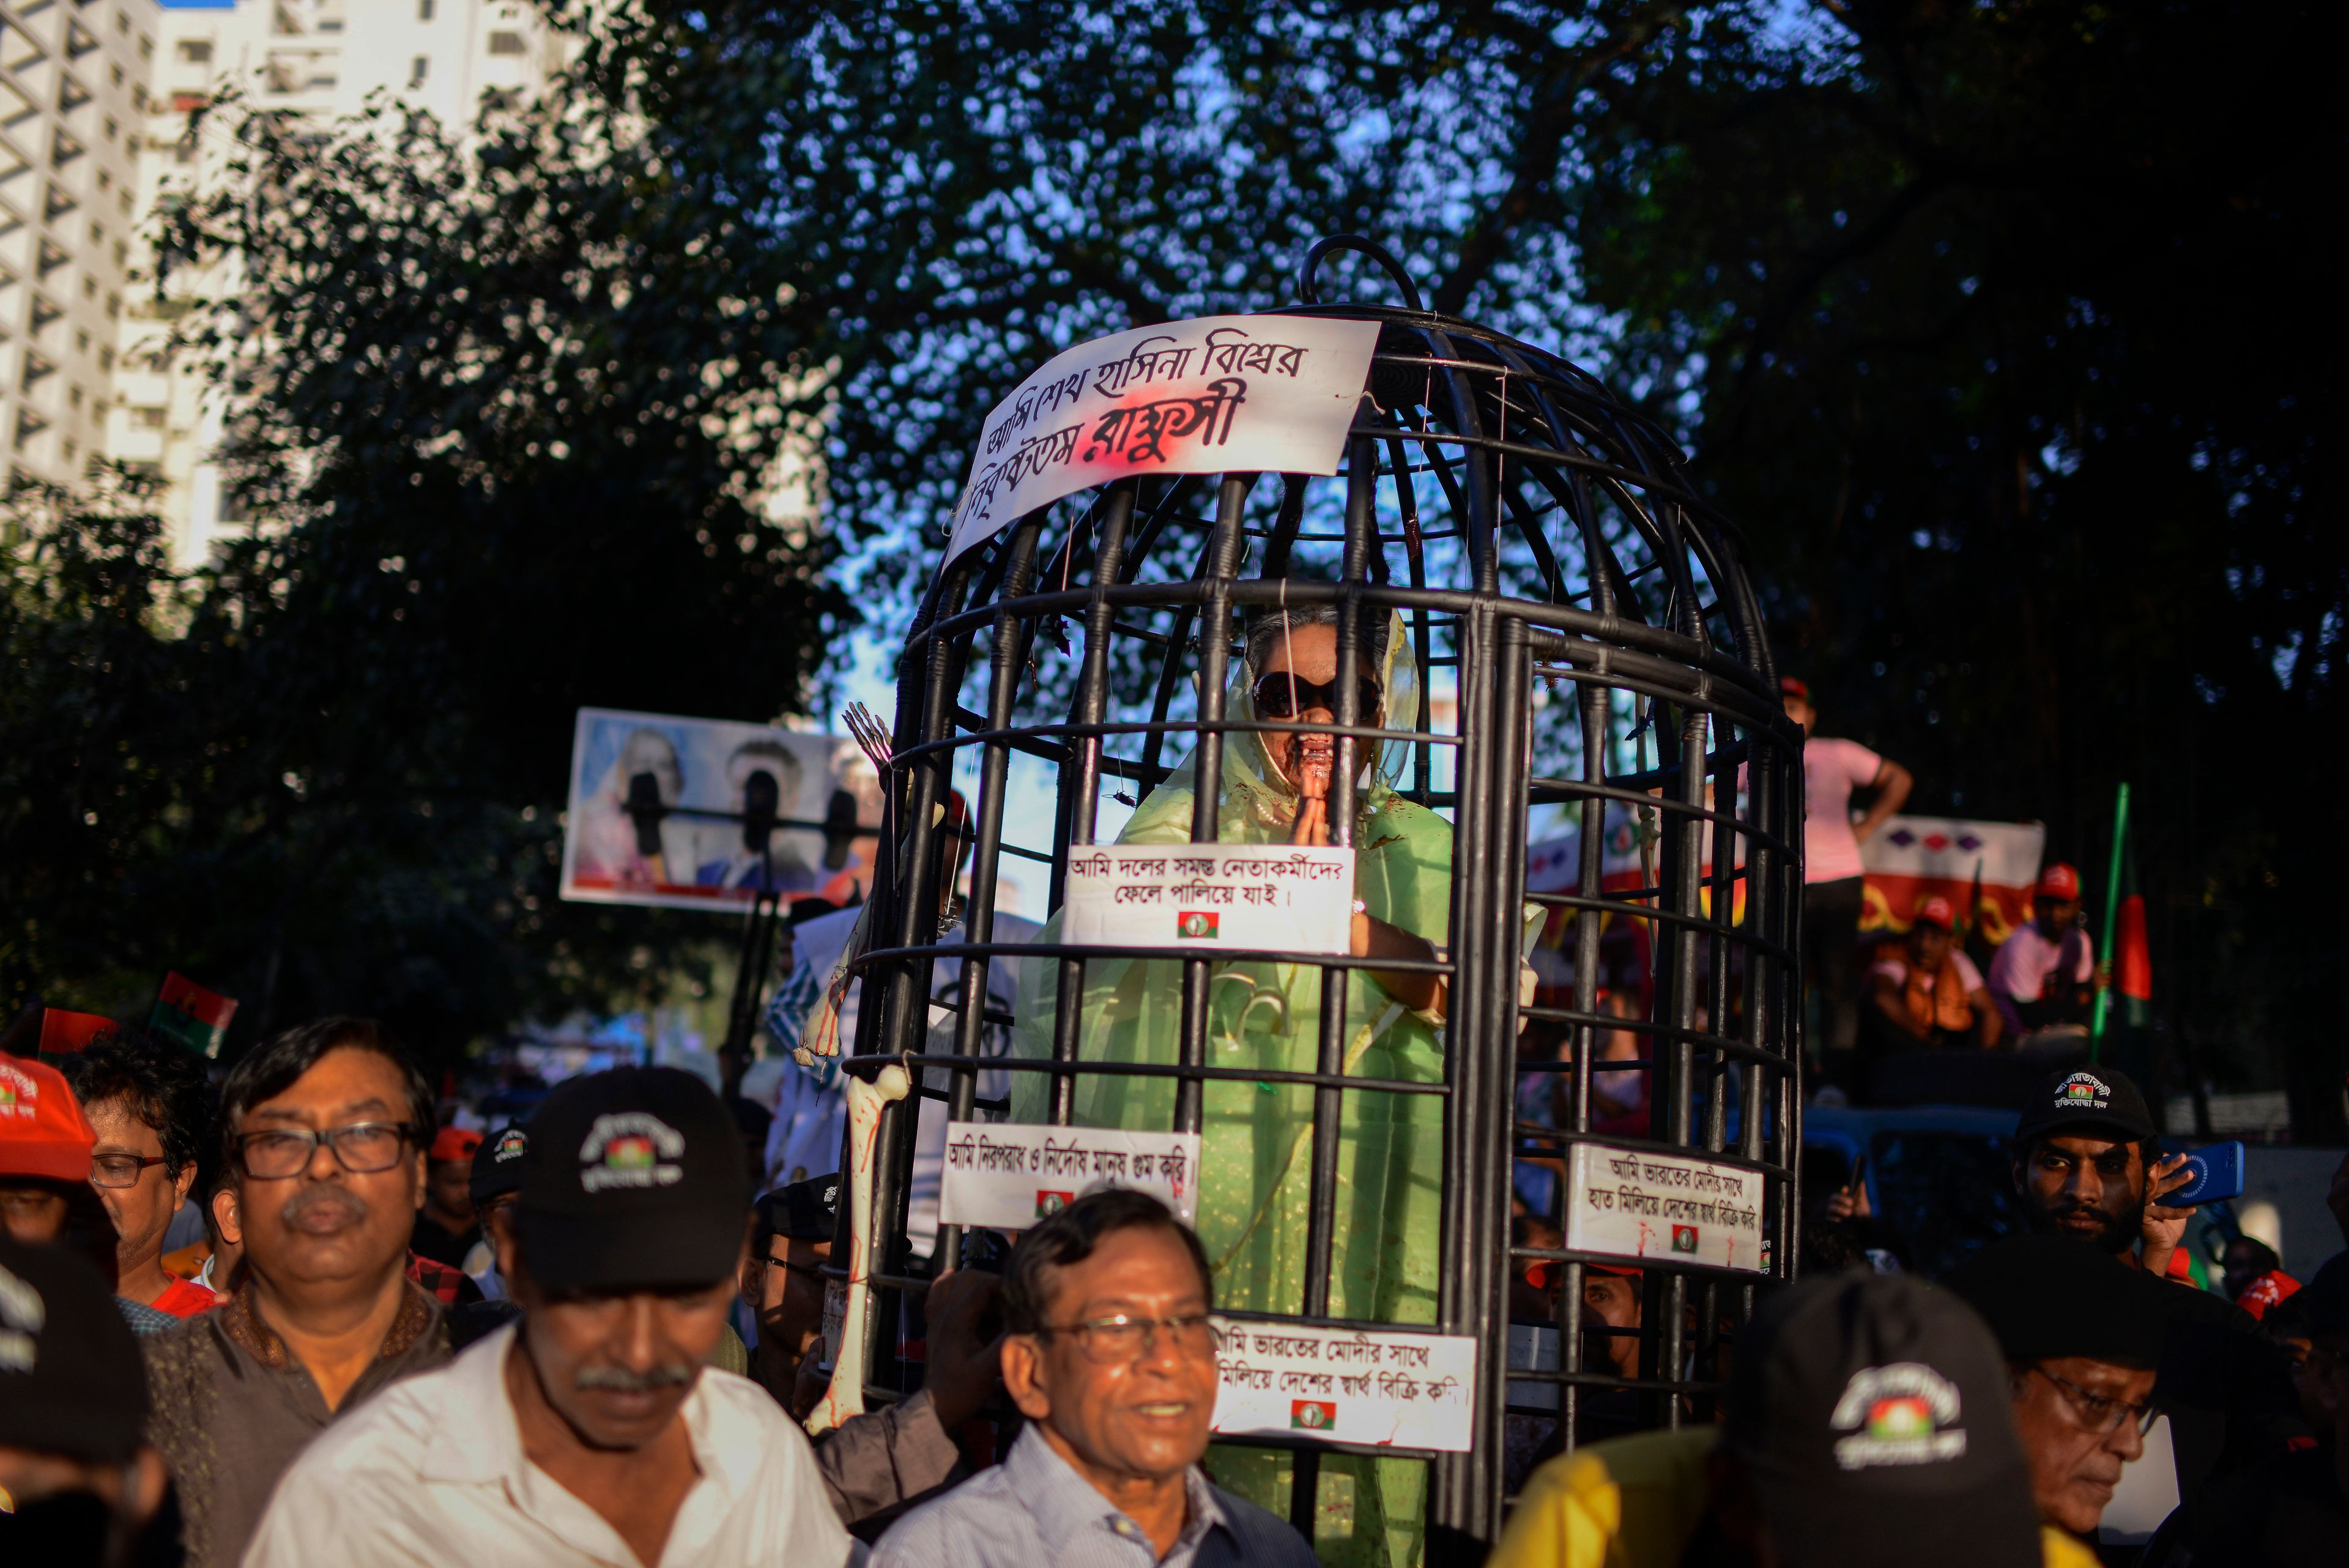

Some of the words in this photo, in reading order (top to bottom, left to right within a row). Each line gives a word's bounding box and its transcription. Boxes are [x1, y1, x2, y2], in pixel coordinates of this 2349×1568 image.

[986, 385, 1038, 455] আমি
[1033, 368, 1091, 422] শেখ
[1093, 335, 1198, 398] হাসিনা
[1200, 327, 1309, 377] বিশ্বের
[1071, 852, 1112, 878] আমি
[1118, 858, 1168, 878] দলের
[1173, 858, 1216, 877] সমস্ত
[1223, 853, 1345, 880] নেতাকর্মীদের
[1114, 885, 1164, 904] ফেলে
[1170, 878, 1236, 905] পালিয়ে
[2054, 1097, 2093, 1109] মুক্তিযোদ্ধা
[2094, 1099, 2107, 1109] দল
[949, 1134, 976, 1171] আমি
[978, 1134, 1028, 1175] নিরপরাধ
[1030, 1148, 1039, 1172] ও
[1044, 1137, 1088, 1178] নির্দোষ
[1093, 1150, 1127, 1188] মানুষ
[1133, 1154, 1155, 1181] গুম
[1608, 1154, 1640, 1182] আমি
[1643, 1164, 1691, 1188] ভারতের
[1694, 1165, 1721, 1193] মোদীর
[1722, 1176, 1743, 1198] সাথে
[1587, 1187, 1615, 1211] হাত
[1617, 1184, 1660, 1216] মিলিয়ে
[1663, 1198, 1698, 1221] দেশের
[1699, 1197, 1717, 1224] স্বার্থ
[1718, 1199, 1739, 1228] বিক্রি
[1224, 1325, 1247, 1355] মি
[1253, 1334, 1320, 1360] ভারতের
[1327, 1332, 1382, 1365] মোদীর
[1388, 1344, 1430, 1369] সাথে
[1218, 1358, 1274, 1390] মিলিয়ে
[1279, 1370, 1334, 1395] দেশের
[1338, 1369, 1373, 1398] স্বার্থ
[1377, 1370, 1420, 1402] বিক্রি
